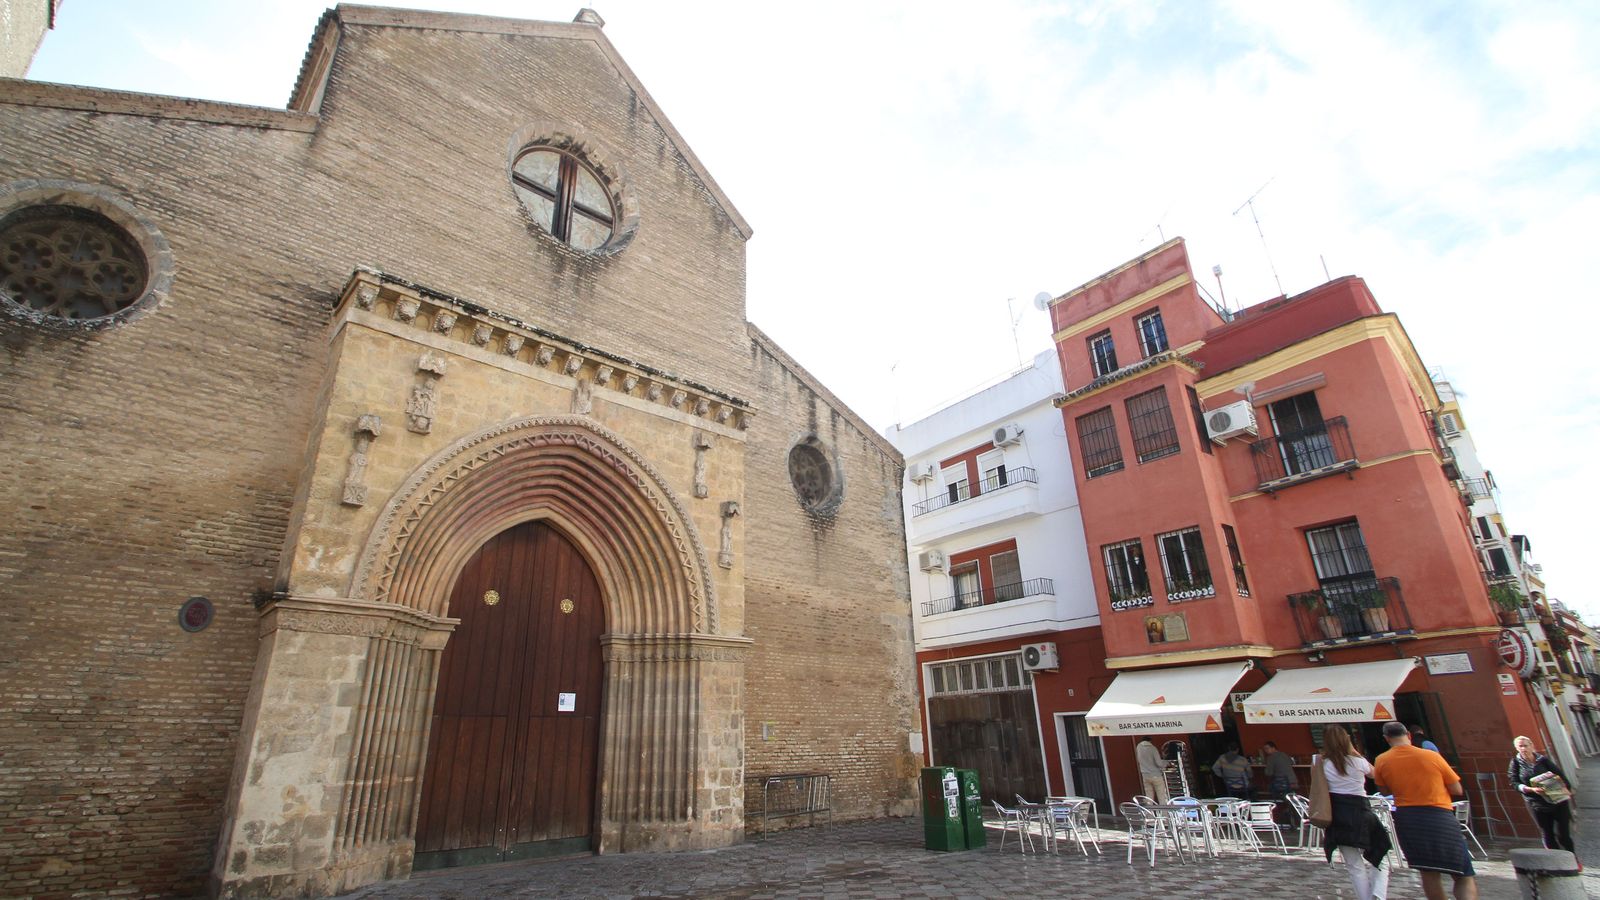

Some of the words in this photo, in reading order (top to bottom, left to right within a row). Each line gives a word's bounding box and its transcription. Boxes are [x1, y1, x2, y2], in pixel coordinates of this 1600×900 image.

[1278, 709, 1296, 717] BAR
[1297, 708, 1326, 717] SANTA
[1327, 707, 1364, 716] MARINA
[1155, 720, 1183, 728] MARINA
